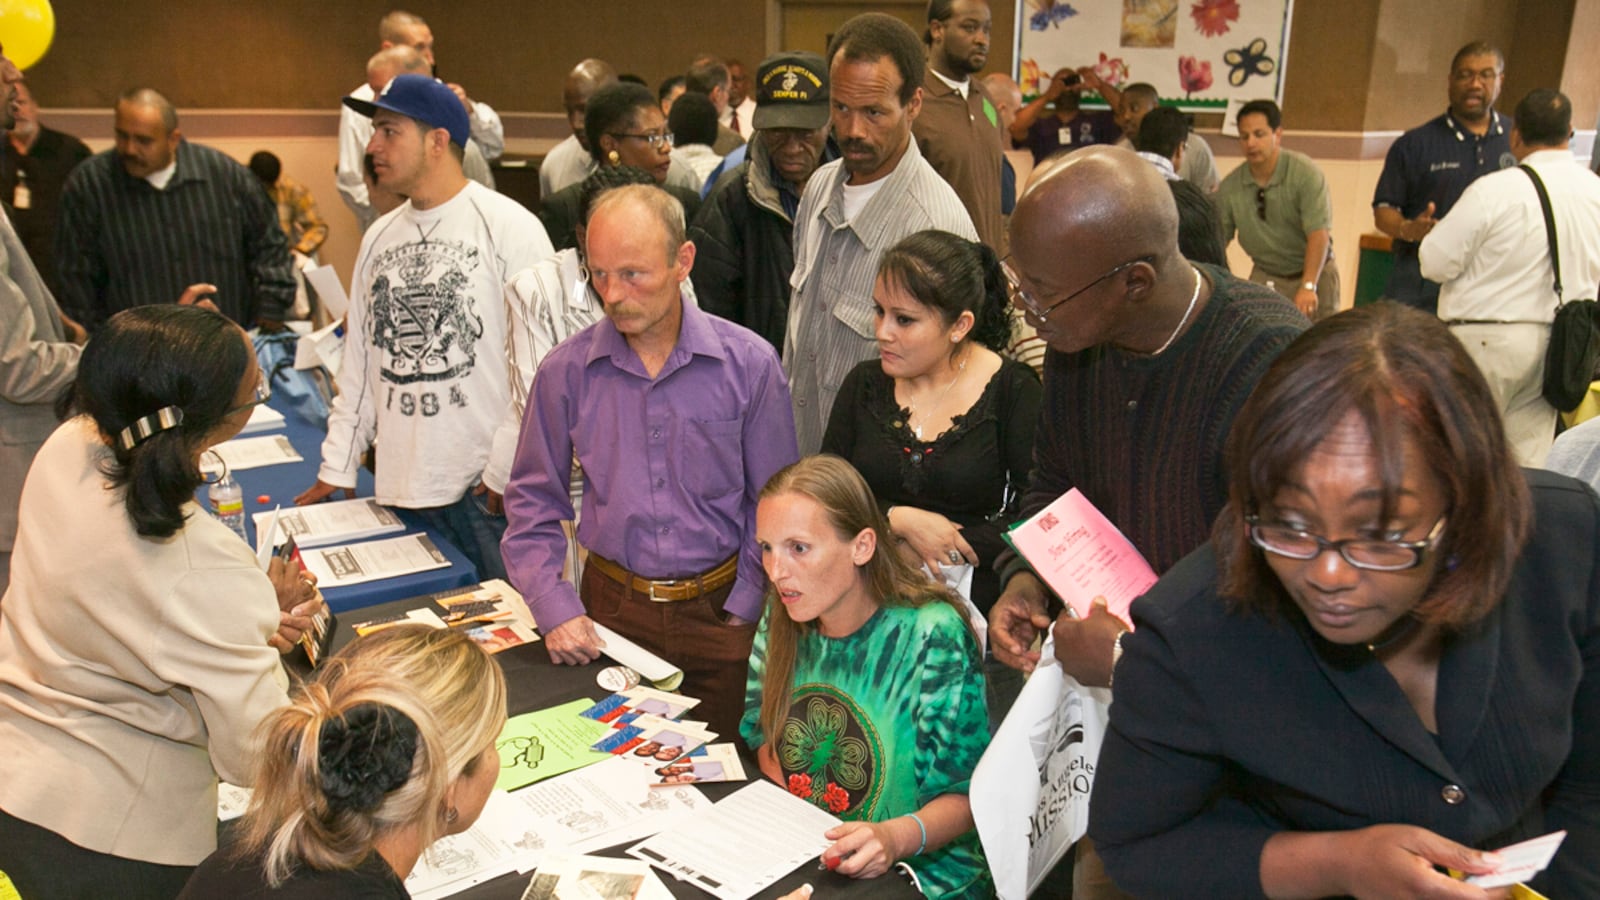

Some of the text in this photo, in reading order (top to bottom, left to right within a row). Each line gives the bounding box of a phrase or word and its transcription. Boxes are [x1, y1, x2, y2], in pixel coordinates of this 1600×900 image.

[773, 90, 808, 99] SEMPER FI
[386, 383, 468, 416] 1984
[1050, 755, 1094, 793] Angele
